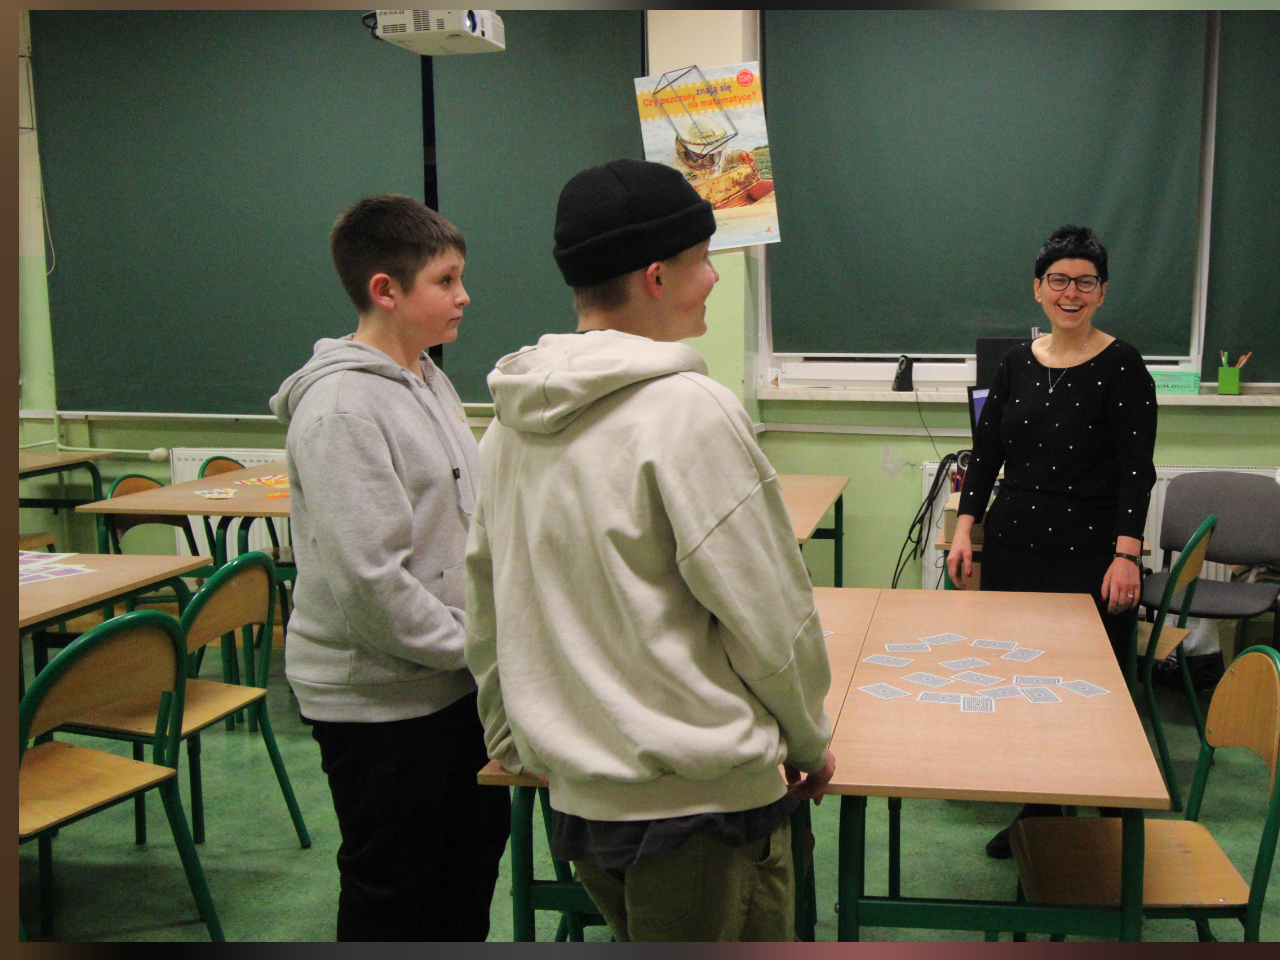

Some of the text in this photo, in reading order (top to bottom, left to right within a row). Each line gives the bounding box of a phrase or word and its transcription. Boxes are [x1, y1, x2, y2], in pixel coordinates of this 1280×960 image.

[696, 83, 732, 96] znają się
[643, 93, 696, 107] Czy pszczoły
[688, 91, 757, 109] na matematyce?
